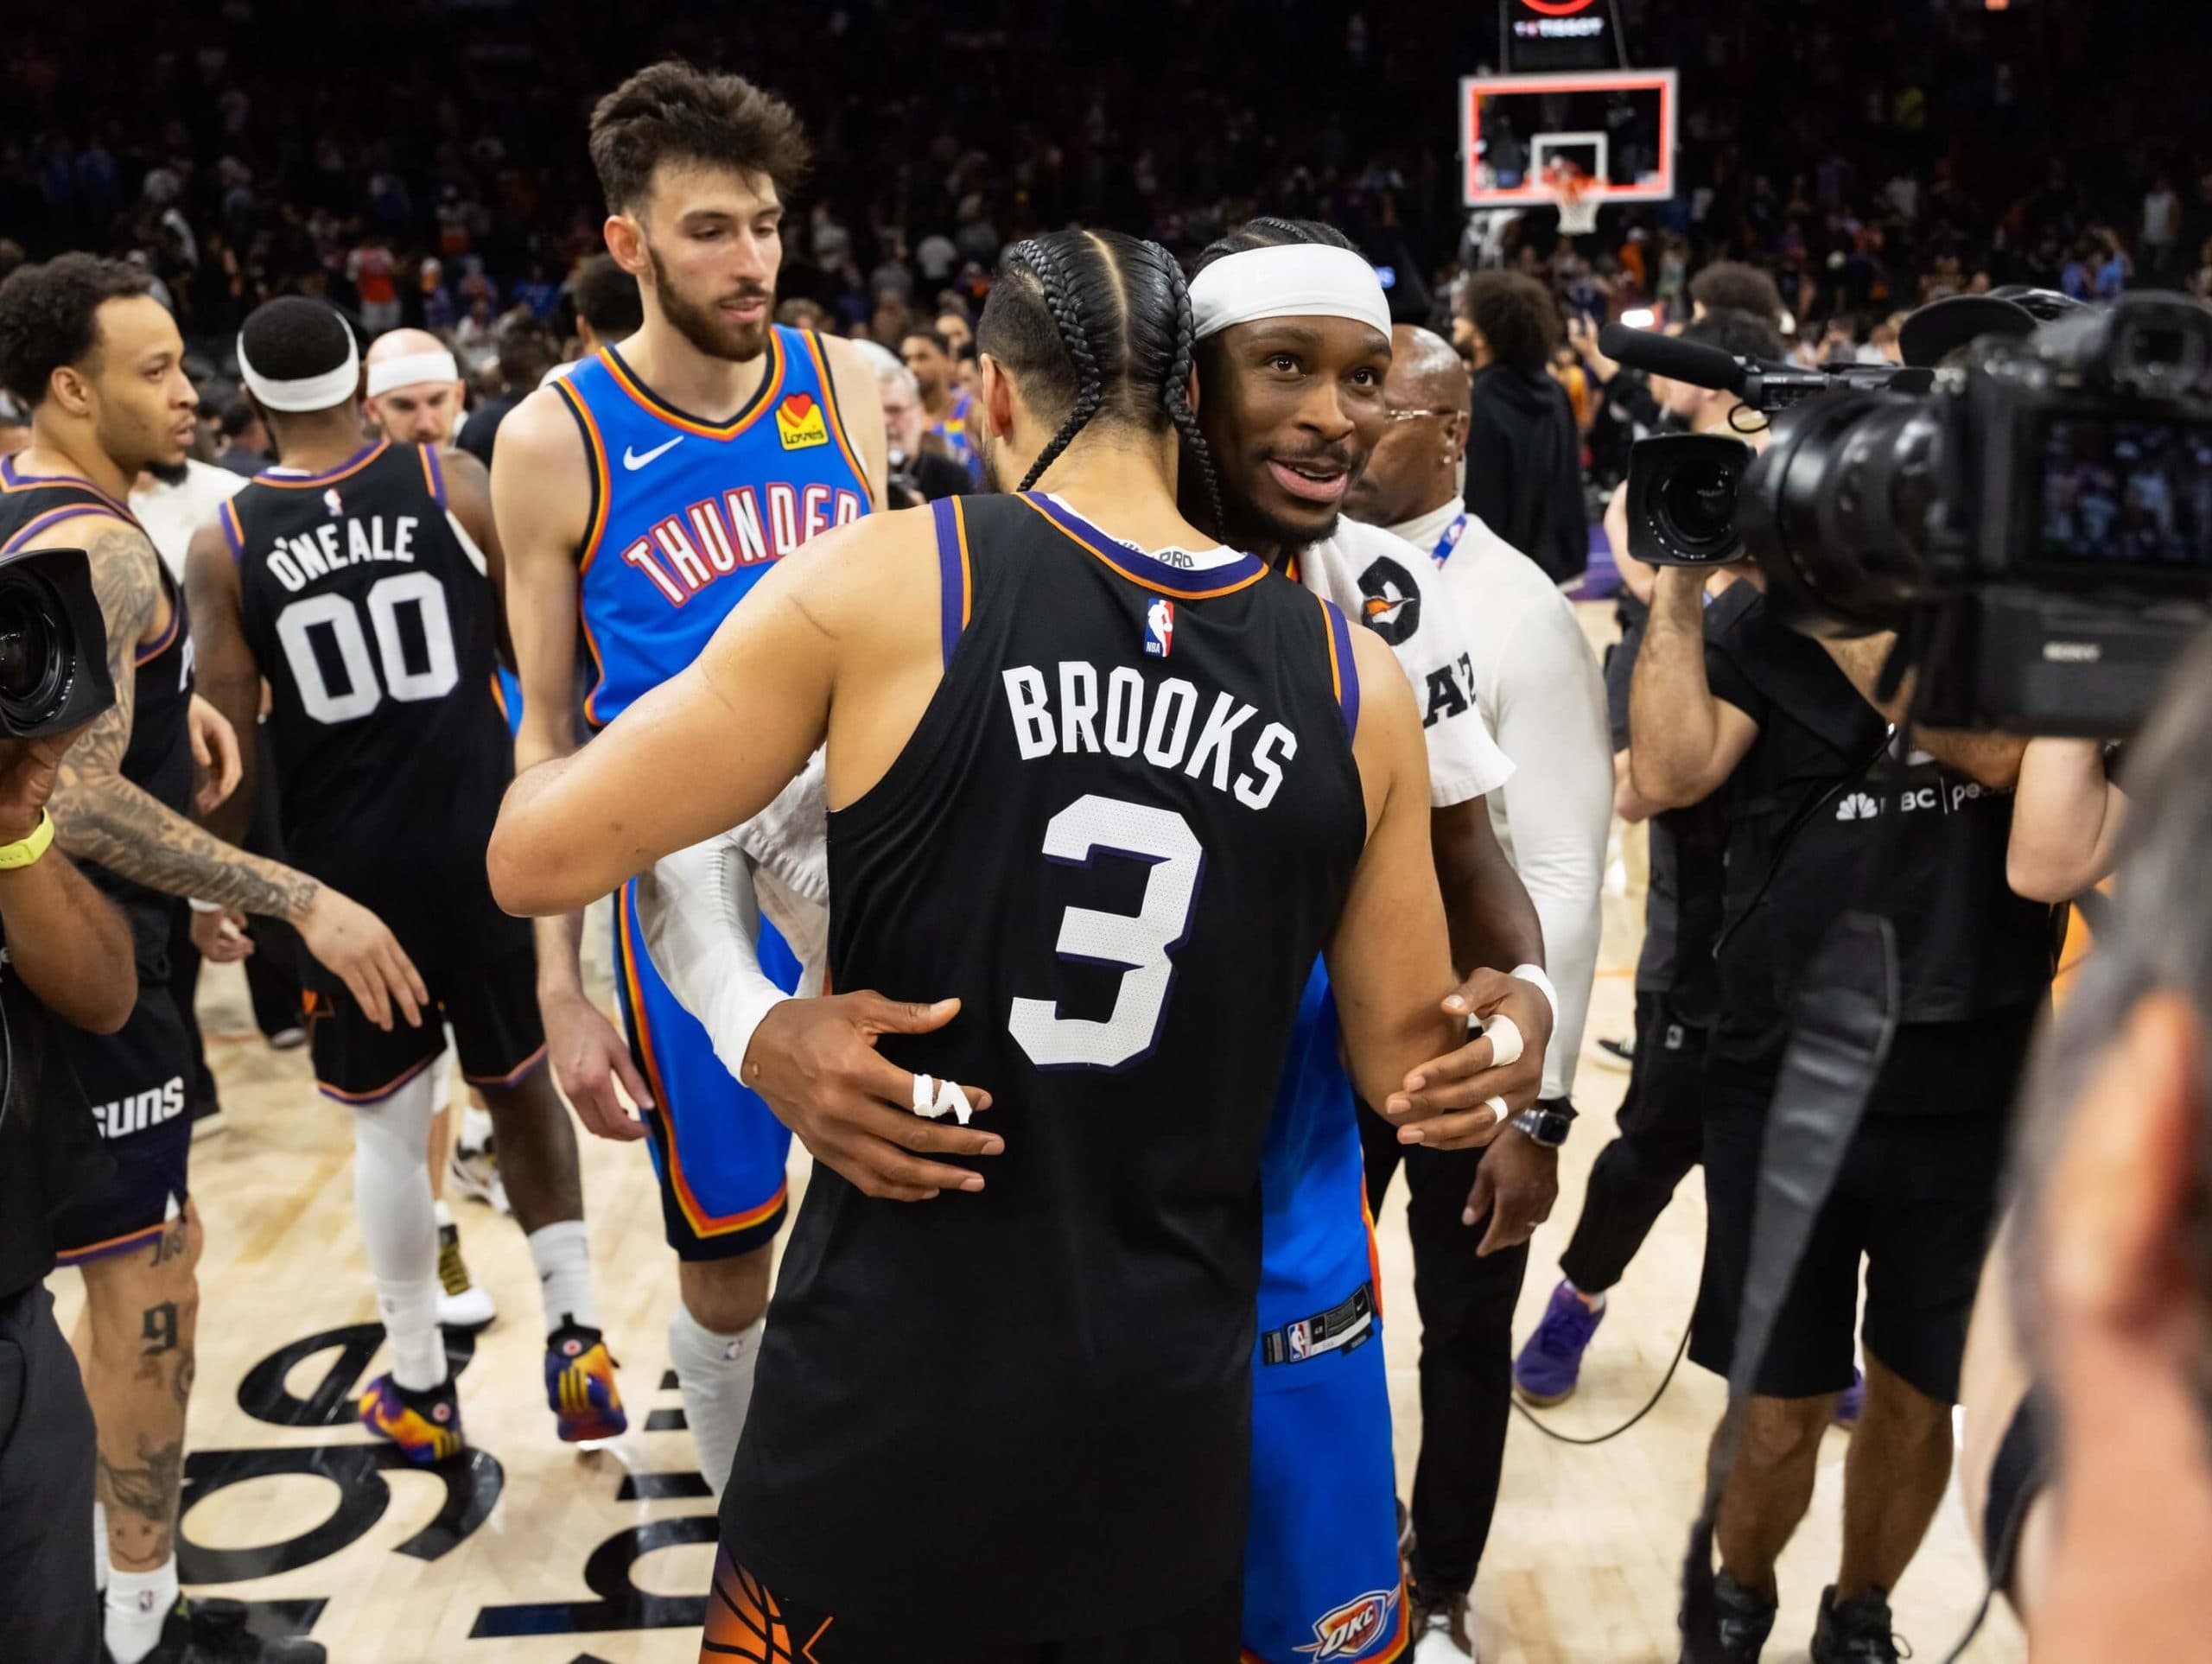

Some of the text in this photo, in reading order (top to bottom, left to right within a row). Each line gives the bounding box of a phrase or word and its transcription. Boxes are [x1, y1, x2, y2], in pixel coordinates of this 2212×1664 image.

[266, 517, 418, 592] O'NEALE
[276, 570, 460, 725] 00
[1002, 661, 1299, 811] BROOKS
[1008, 794, 1204, 1071] 3
[1319, 1604, 1375, 1658] OKC
